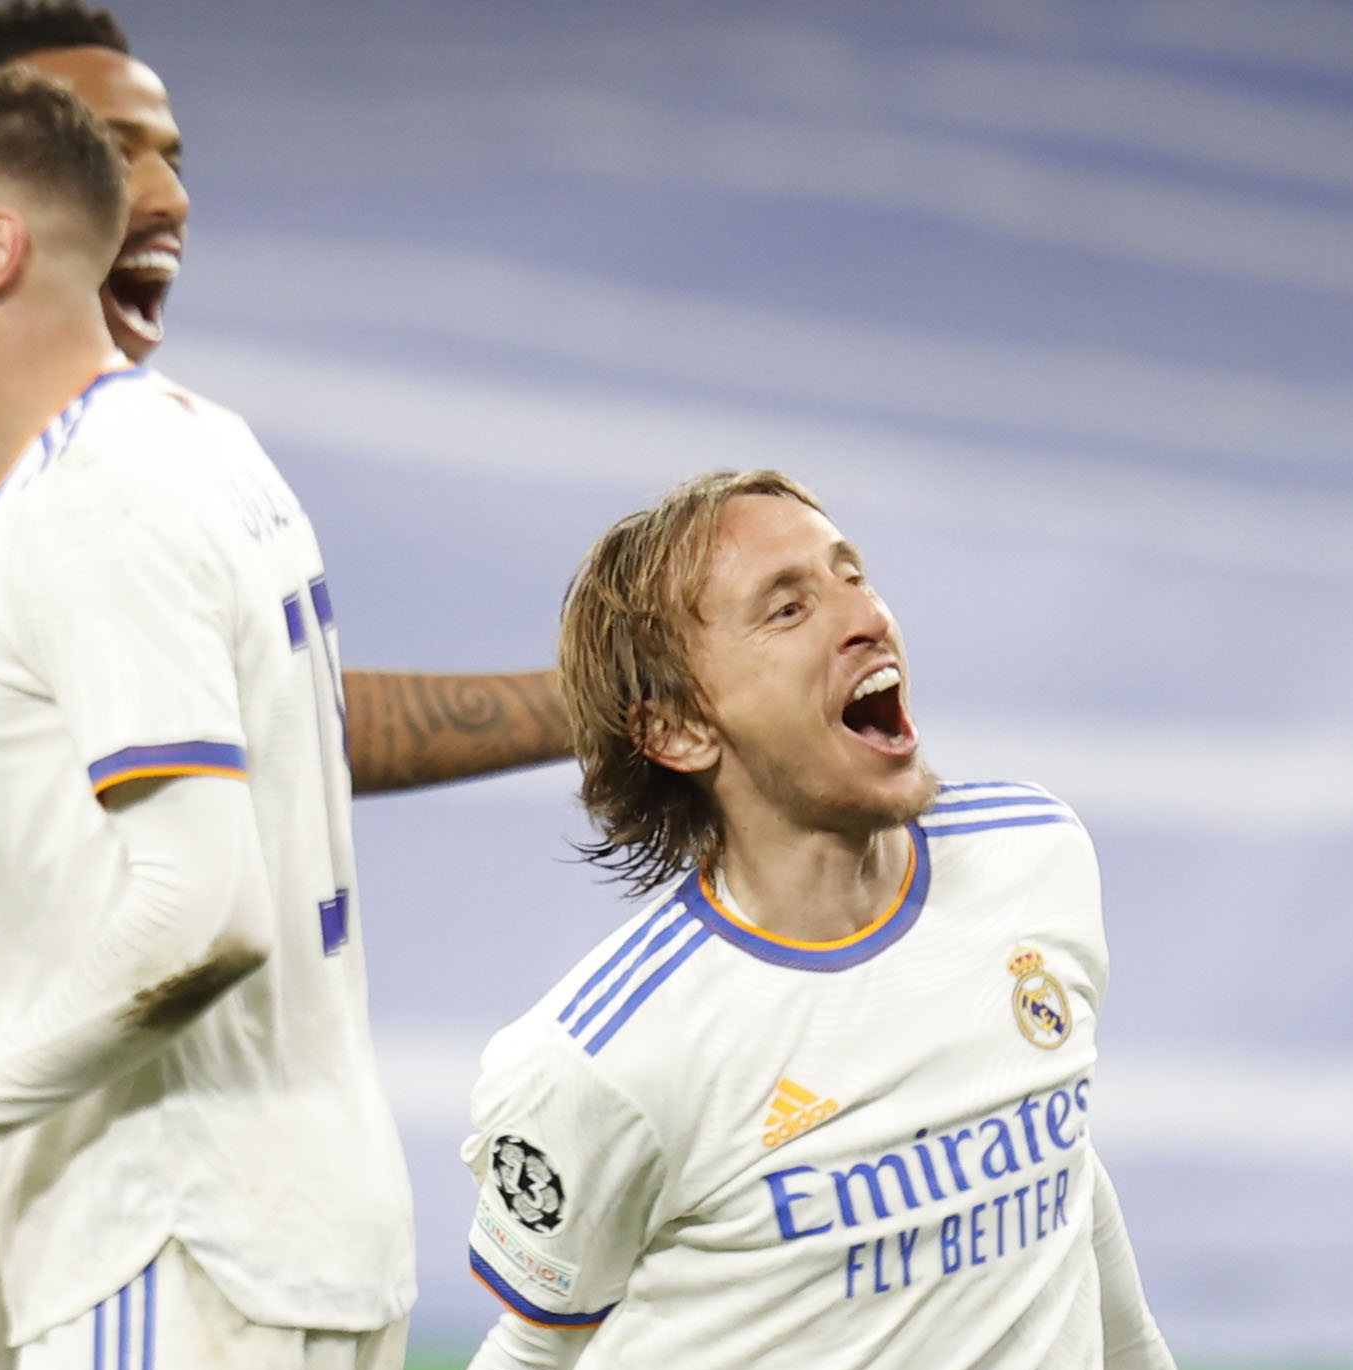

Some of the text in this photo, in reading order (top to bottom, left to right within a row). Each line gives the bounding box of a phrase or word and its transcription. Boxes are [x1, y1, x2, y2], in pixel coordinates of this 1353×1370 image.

[762, 1077, 1090, 1241] Emirates
[845, 1168, 1069, 1300] FLY BETTER
